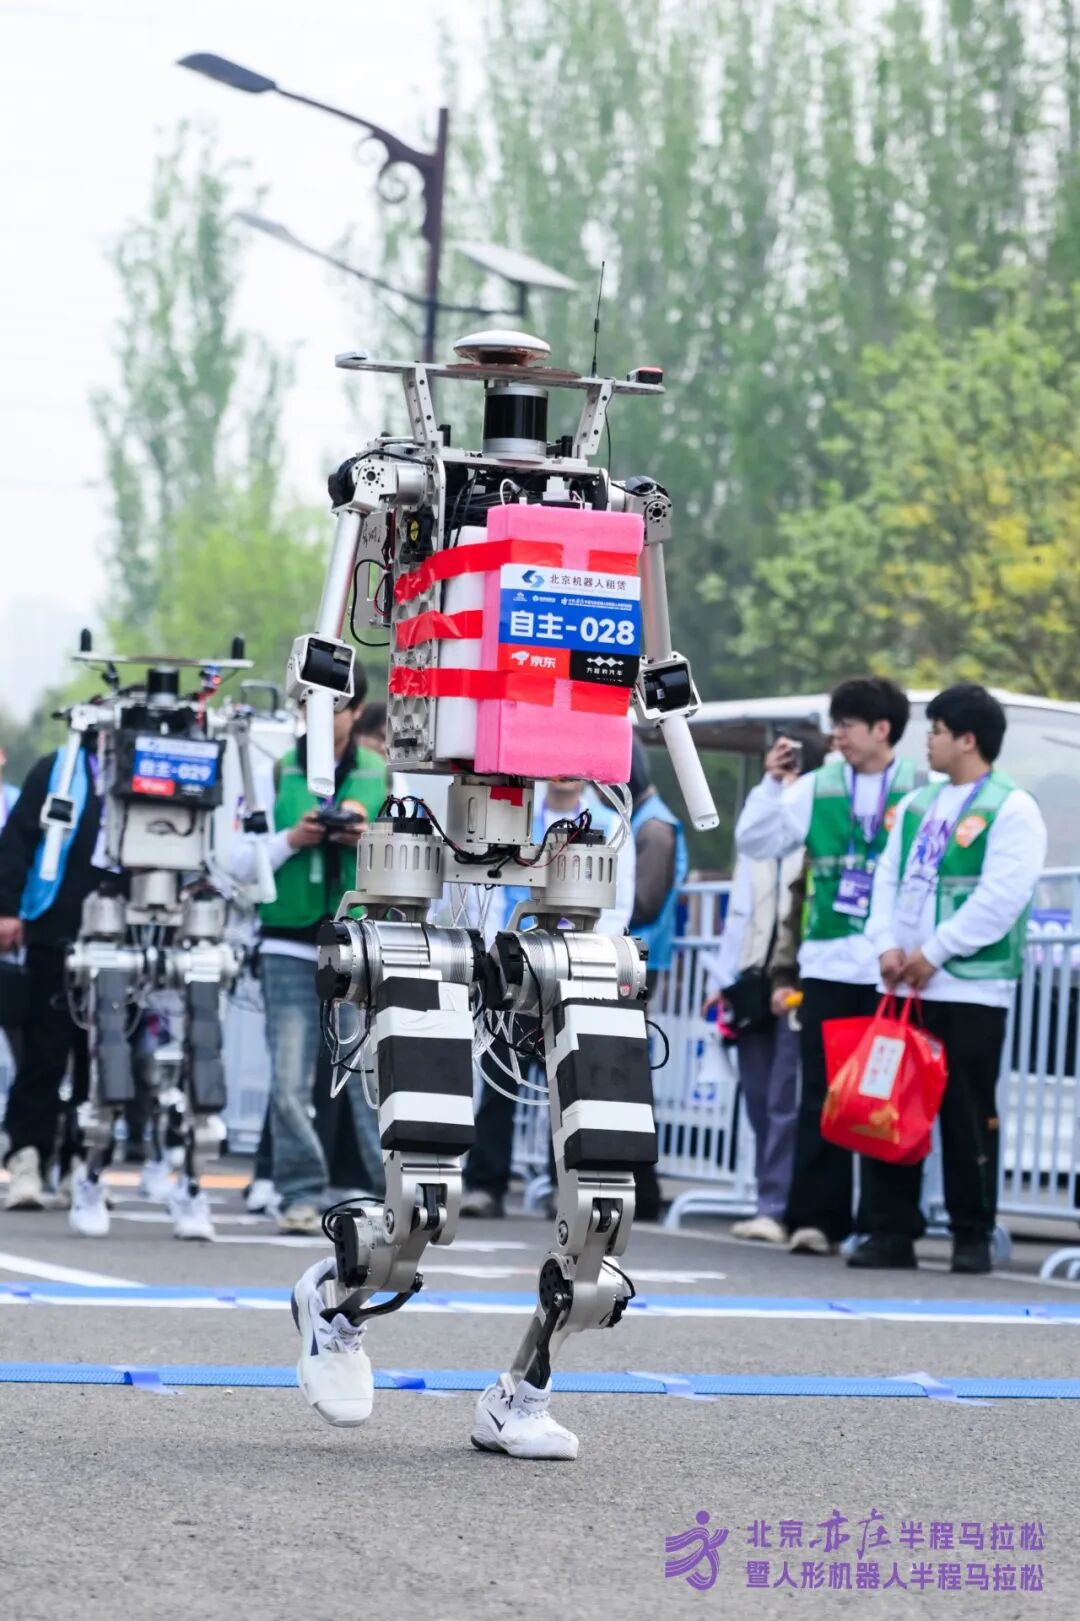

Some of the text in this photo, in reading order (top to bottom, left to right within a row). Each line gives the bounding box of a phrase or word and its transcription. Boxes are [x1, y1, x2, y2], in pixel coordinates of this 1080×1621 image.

[550, 574, 626, 591] 北京机器人租赁
[510, 610, 635, 645] 自主-028
[531, 655, 556, 669] 京东
